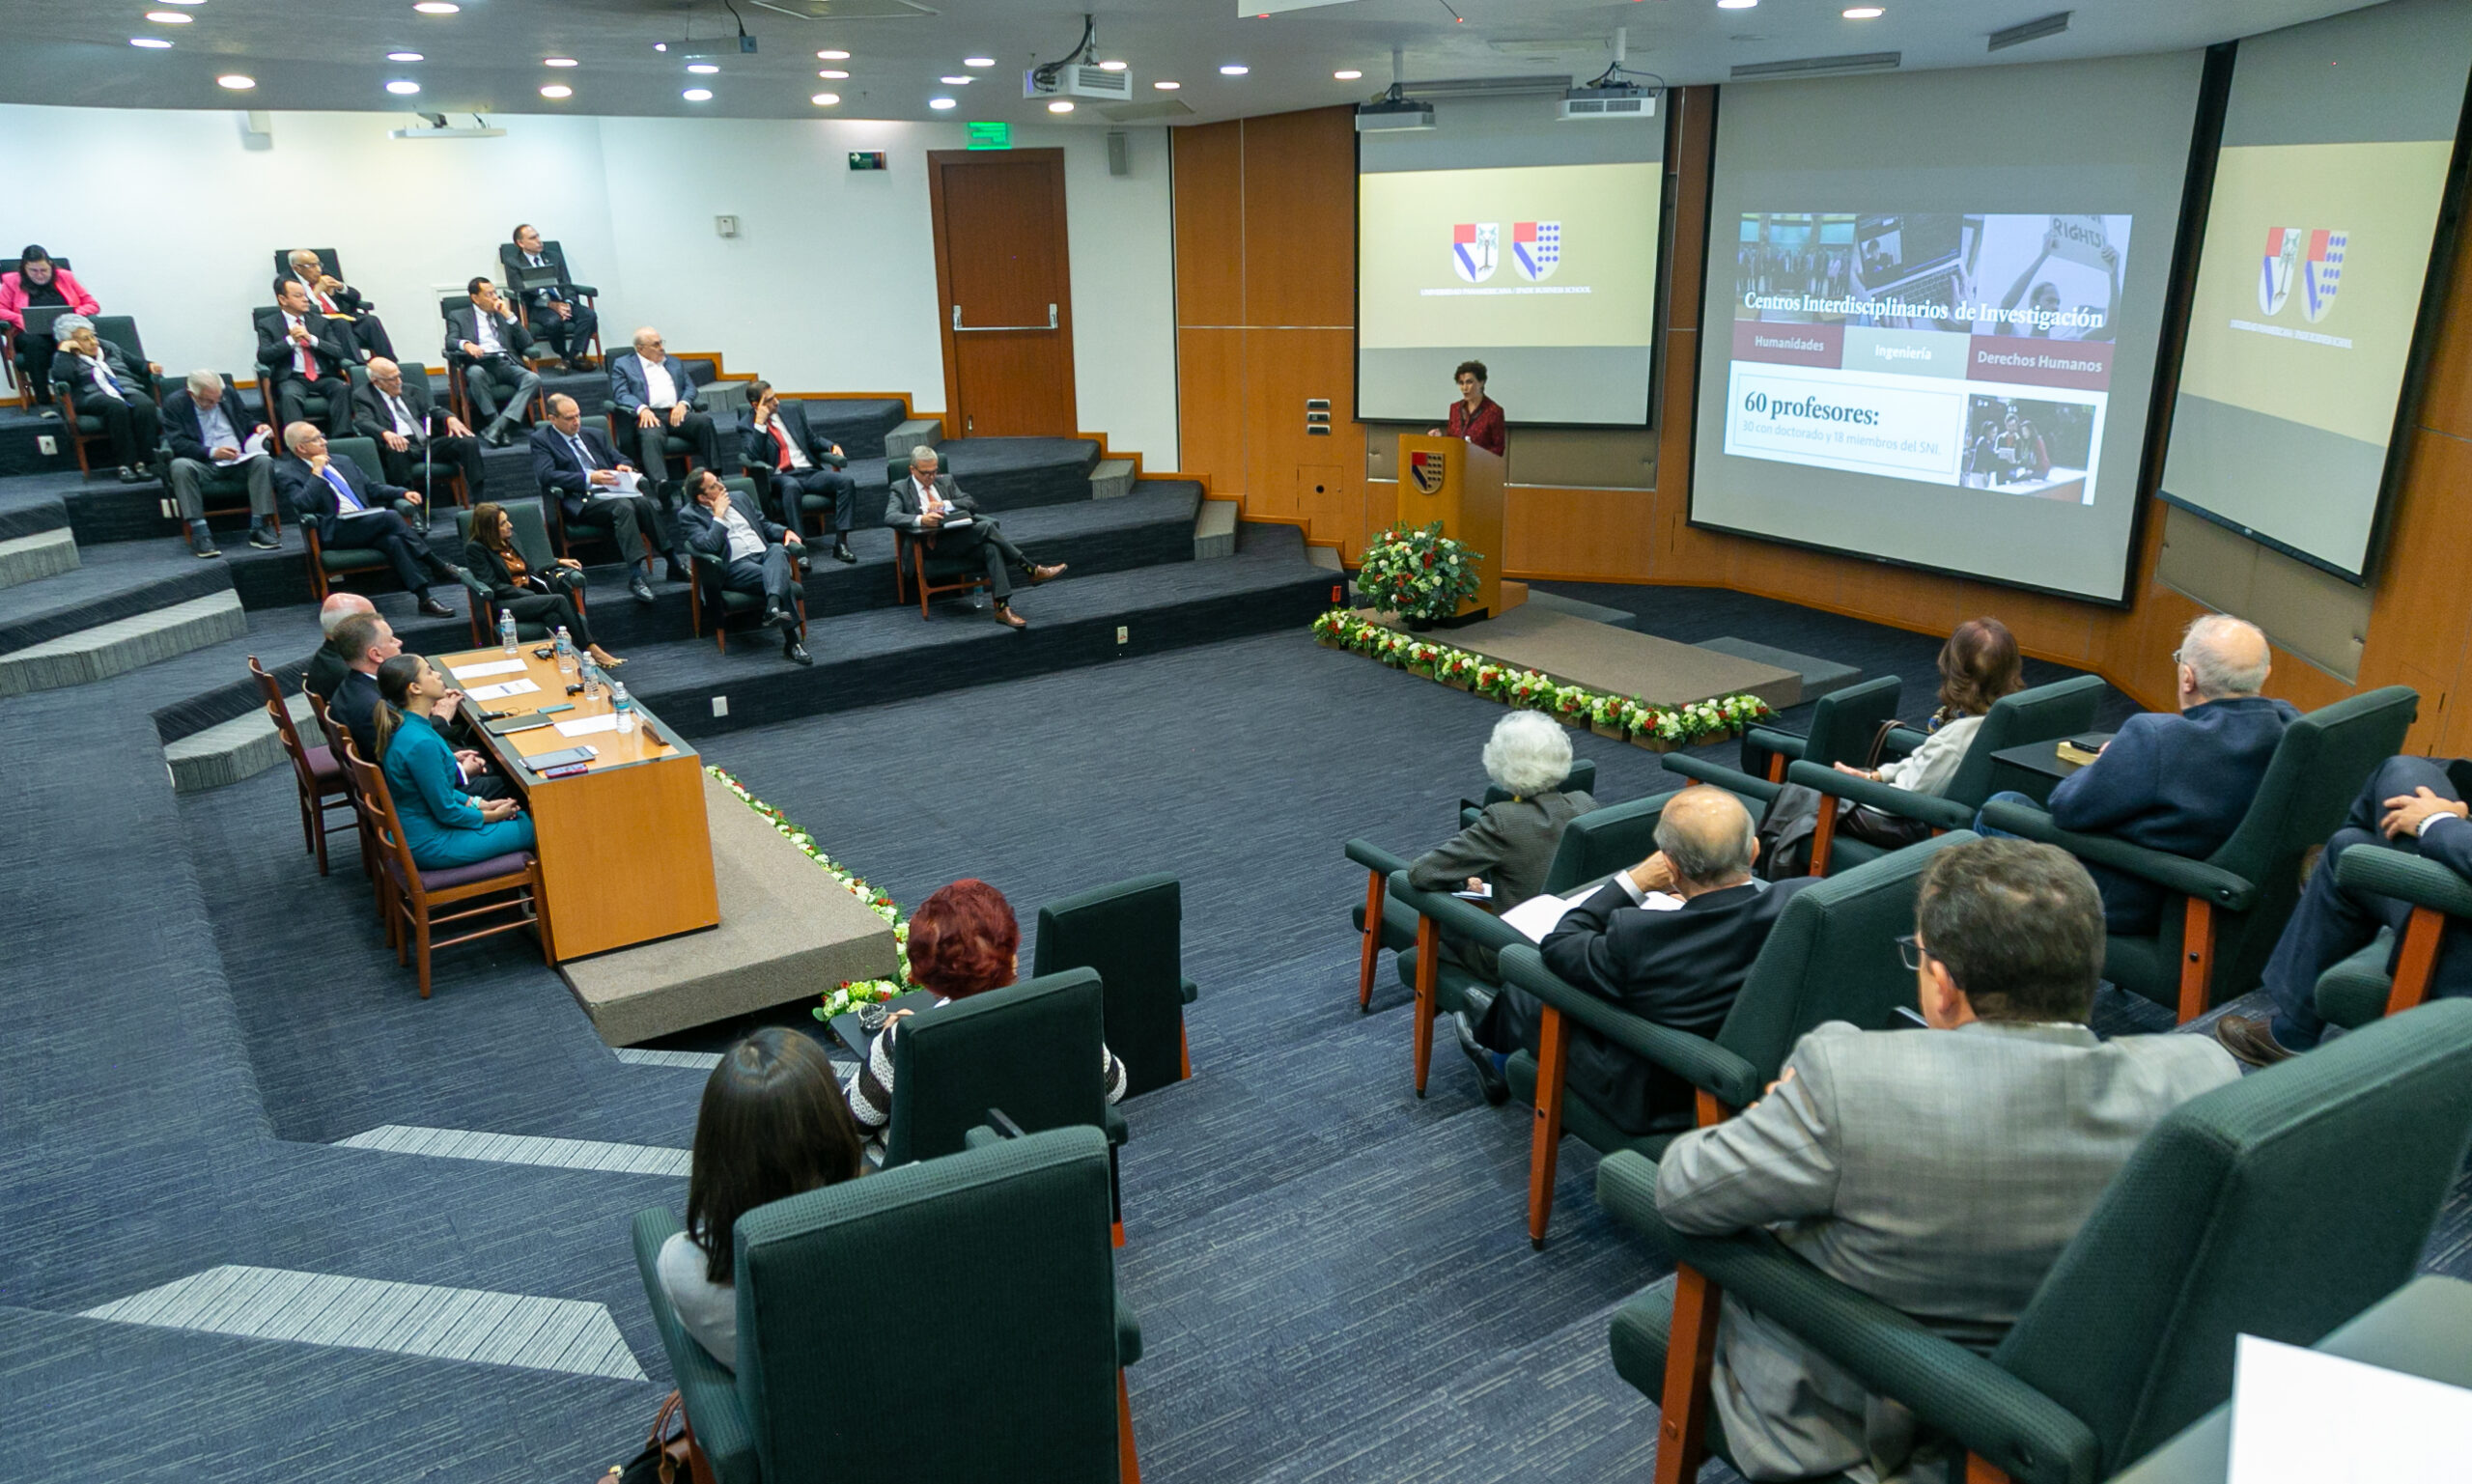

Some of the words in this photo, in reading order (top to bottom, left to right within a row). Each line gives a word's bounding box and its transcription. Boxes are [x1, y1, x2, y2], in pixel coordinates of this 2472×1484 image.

[1744, 292, 1800, 310] Centros
[1803, 294, 1949, 321] Interdisciplinarios
[1954, 300, 1977, 321] de
[1980, 303, 2103, 330] Investigación
[1755, 335, 1824, 351] Humanidades
[1874, 345, 1932, 360] Ingeniería
[1978, 350, 2036, 367] Derechos
[2037, 354, 2103, 373] Humanos
[1744, 391, 1767, 412] 60
[1771, 395, 1879, 426] profesores:
[1742, 420, 1754, 433] 30
[1756, 424, 1774, 434] con
[1775, 424, 1824, 441] doctorado
[1825, 433, 1833, 444] y
[1834, 432, 1844, 443] 18
[1846, 434, 1898, 451] miembros
[1899, 439, 1918, 453] del
